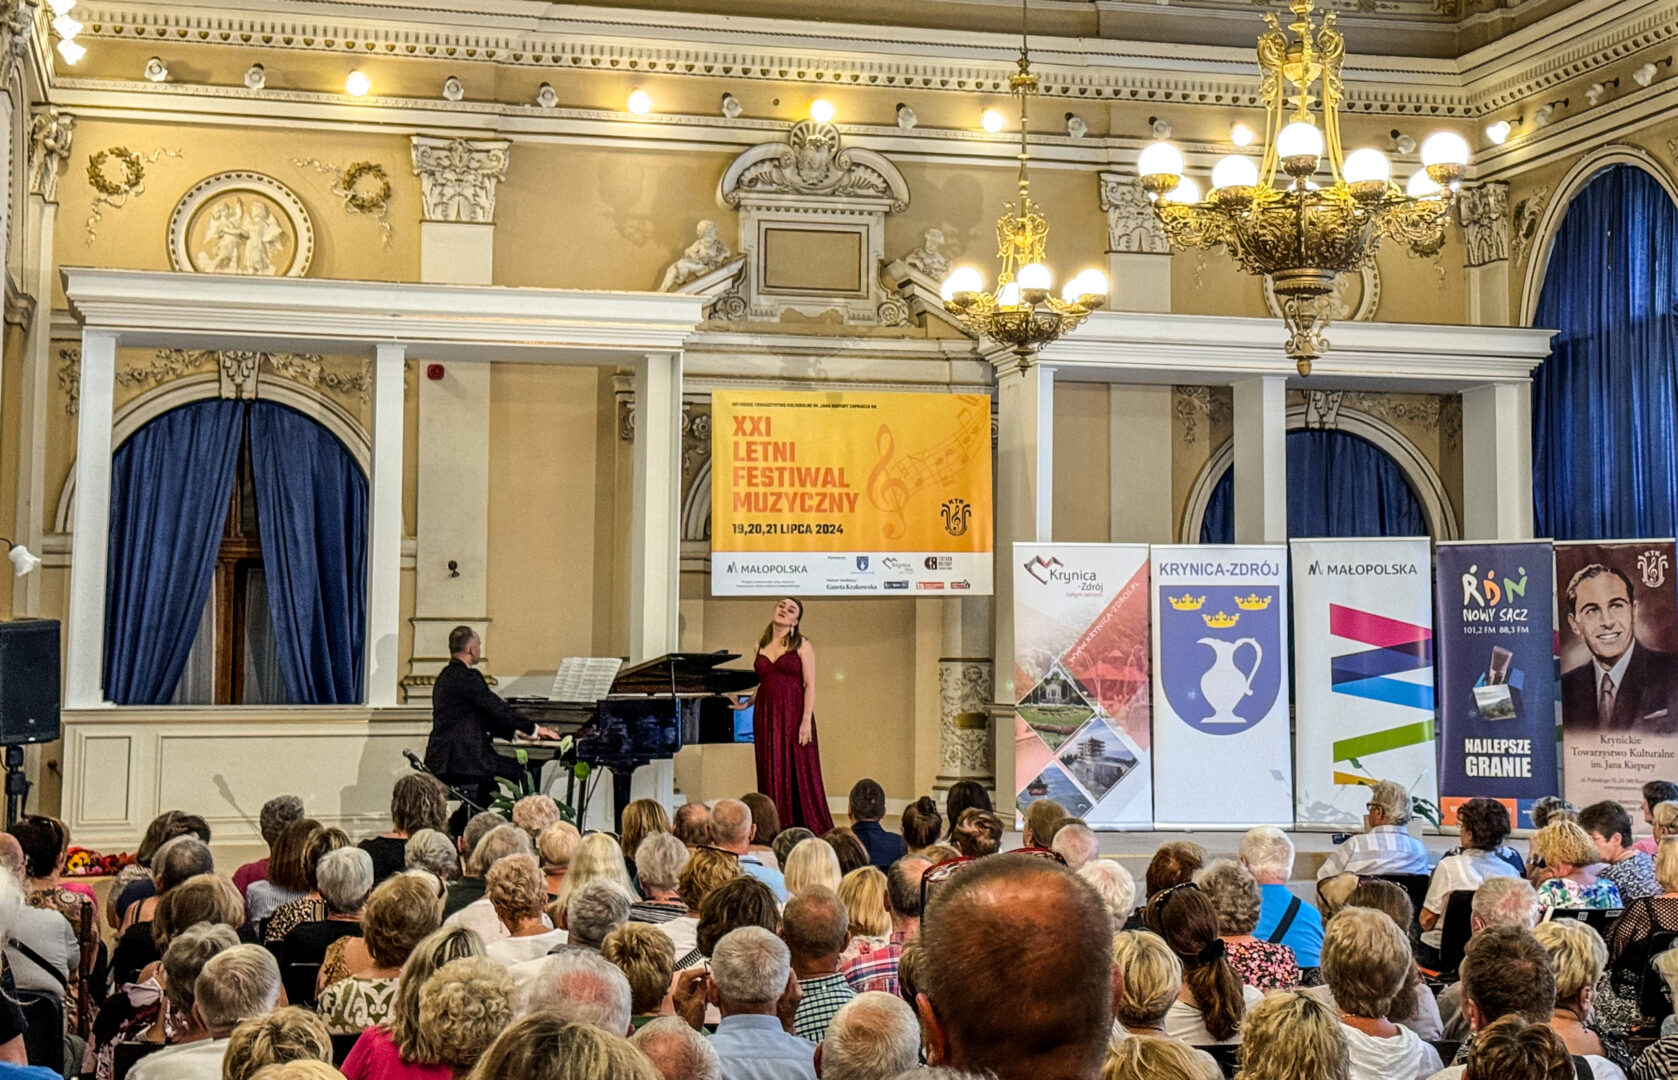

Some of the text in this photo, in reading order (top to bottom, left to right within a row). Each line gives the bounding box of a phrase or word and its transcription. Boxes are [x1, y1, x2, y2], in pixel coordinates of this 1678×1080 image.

[733, 416, 771, 437] XXI
[733, 442, 795, 463] LETNI
[733, 467, 850, 488] FESTIWAL
[733, 492, 860, 513] MUZYCZNY
[732, 524, 844, 535] 19,20,21 LIPCA 2024
[741, 565, 808, 574] MAŁOPOLSKA
[1159, 560, 1280, 577] KRYNICA-ZDRÓJ
[1327, 564, 1417, 575] MAŁOPOLSKA
[1050, 569, 1097, 584] Krynica
[1078, 583, 1104, 592] -Zdrój
[1463, 608, 1495, 622] NOWY
[1465, 738, 1531, 754] NAJLEPSZE
[1600, 735, 1642, 746] Krynickie
[1570, 747, 1675, 759] Towarzystwo Kulturalne
[1465, 756, 1532, 777] GRANIE
[1604, 761, 1622, 770] Jana
[1624, 761, 1656, 771] Kiepury
